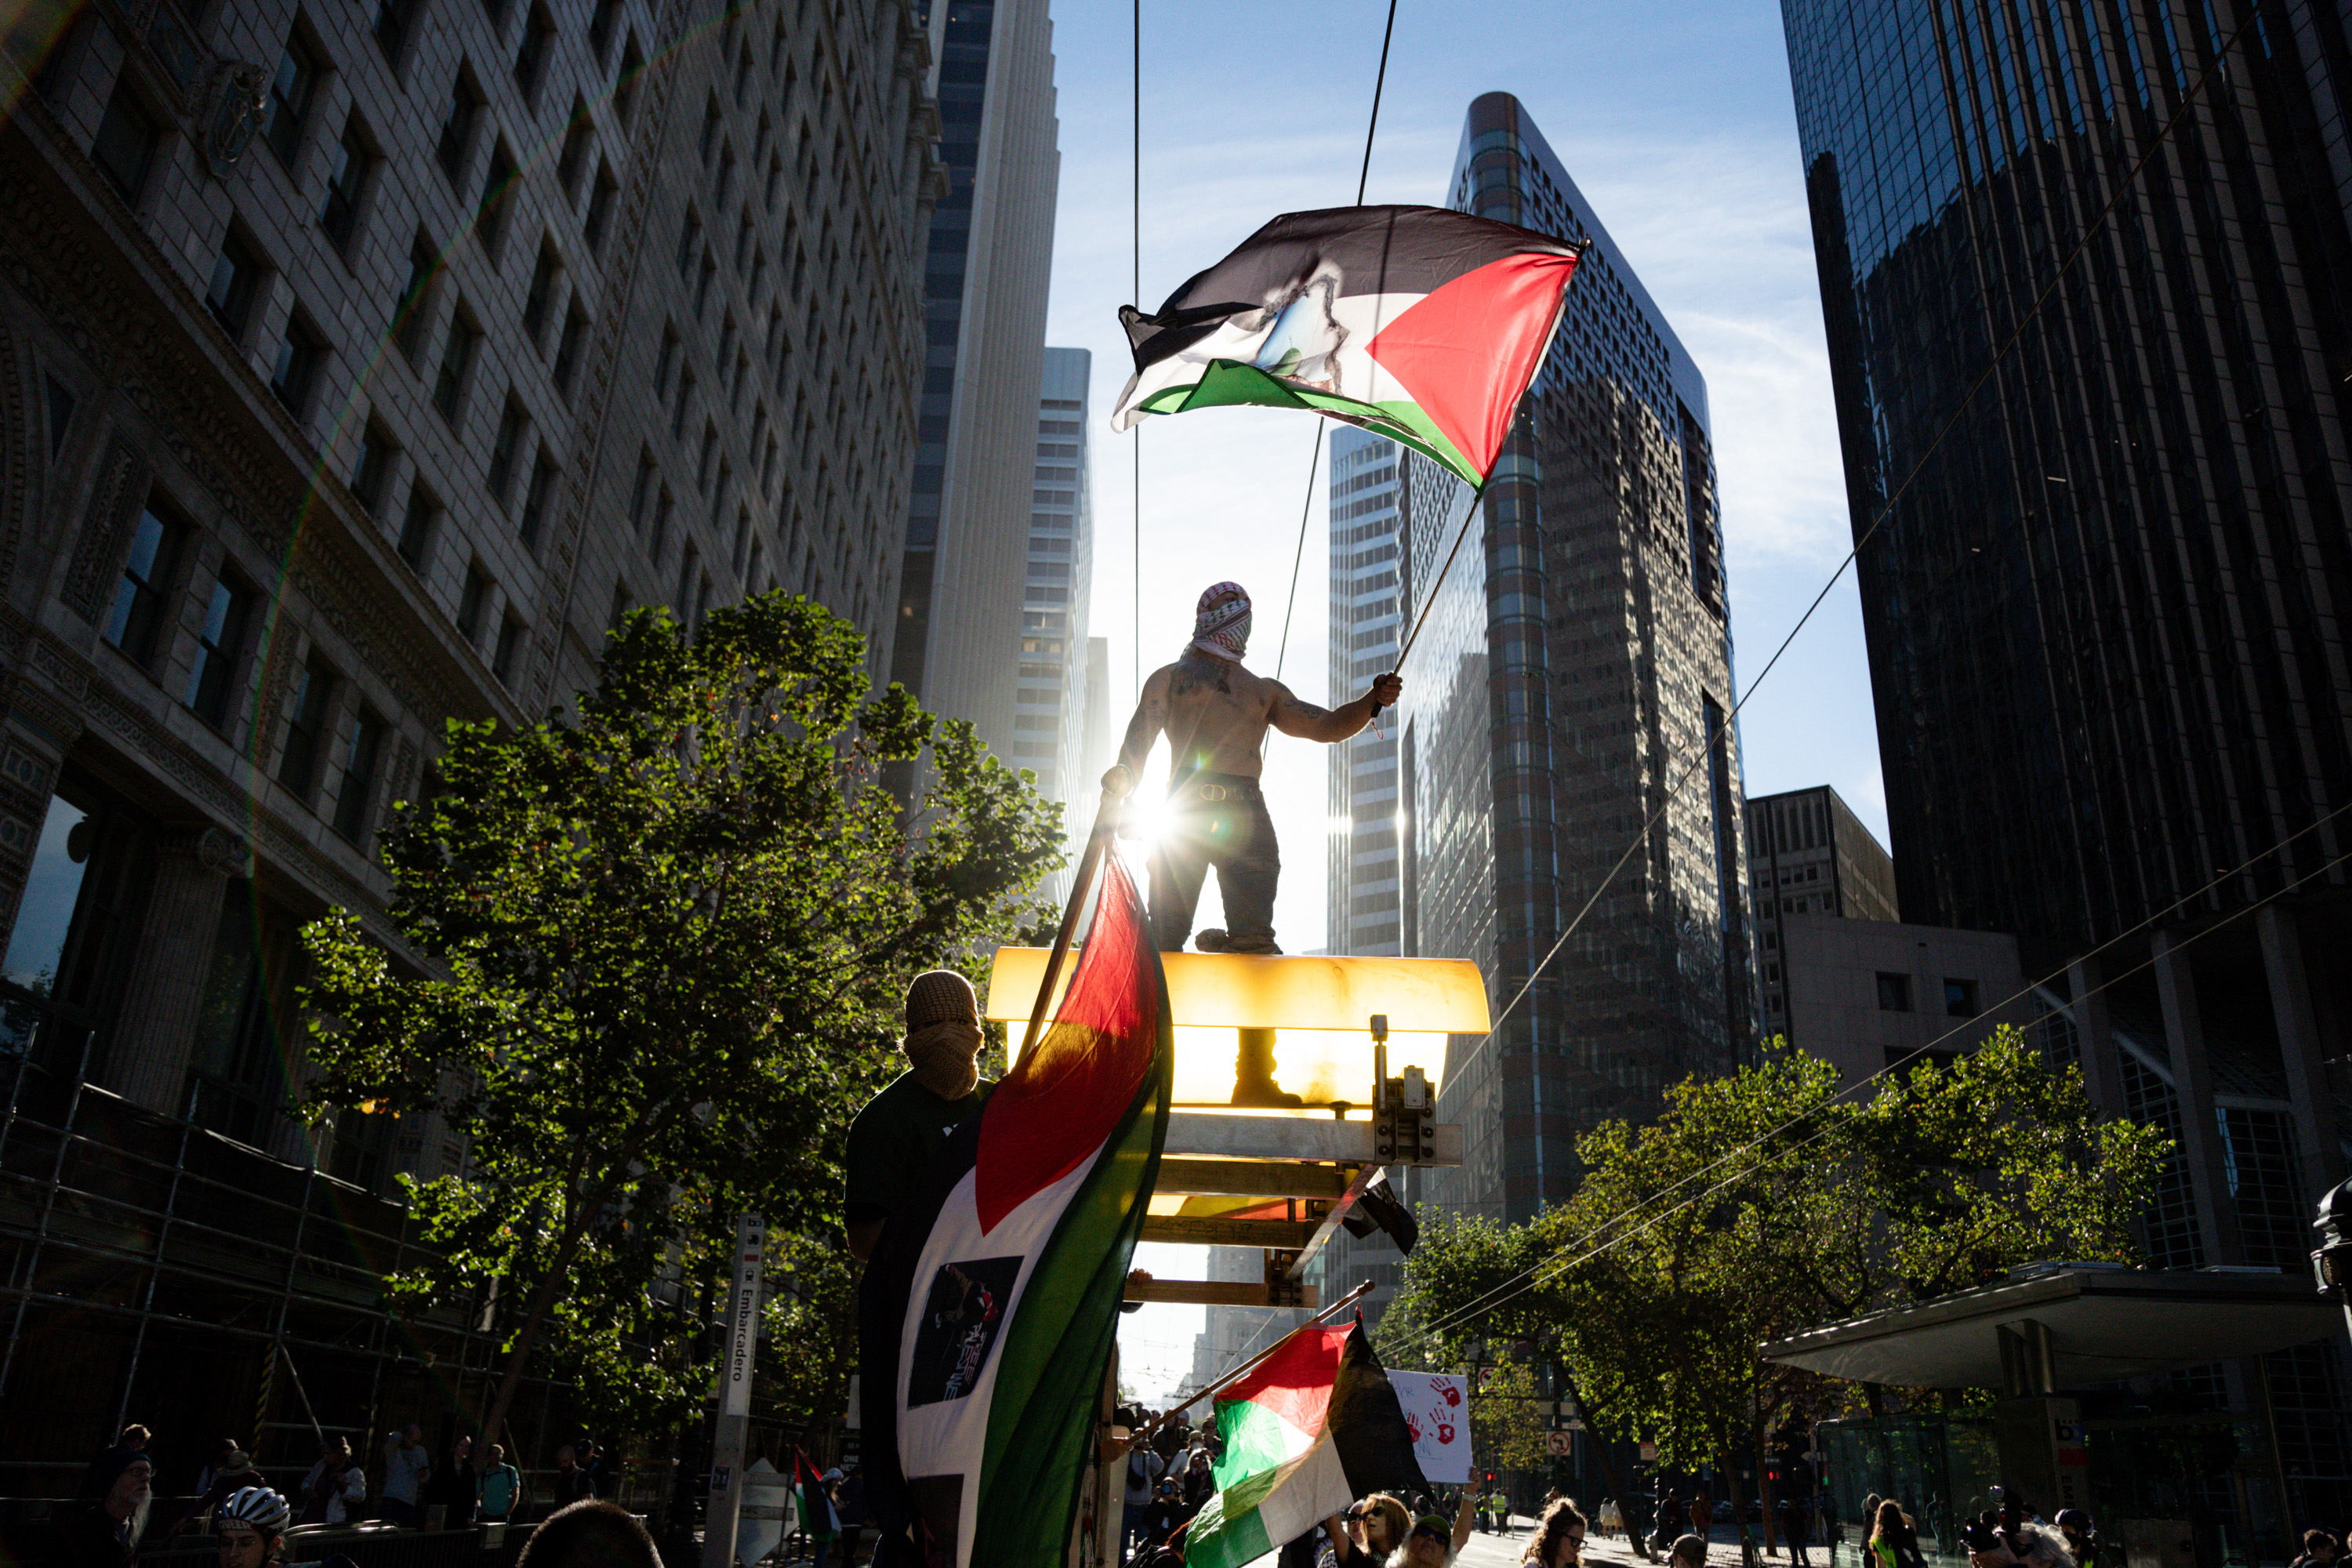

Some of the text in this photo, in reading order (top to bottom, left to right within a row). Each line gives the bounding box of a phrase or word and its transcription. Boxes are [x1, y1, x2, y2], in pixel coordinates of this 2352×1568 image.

[733, 1290, 753, 1381] Embarcadero
[942, 1322, 983, 1401] PALESTINE
[965, 1330, 988, 1386] FREE
[219, 1519, 252, 1530] QUEER
